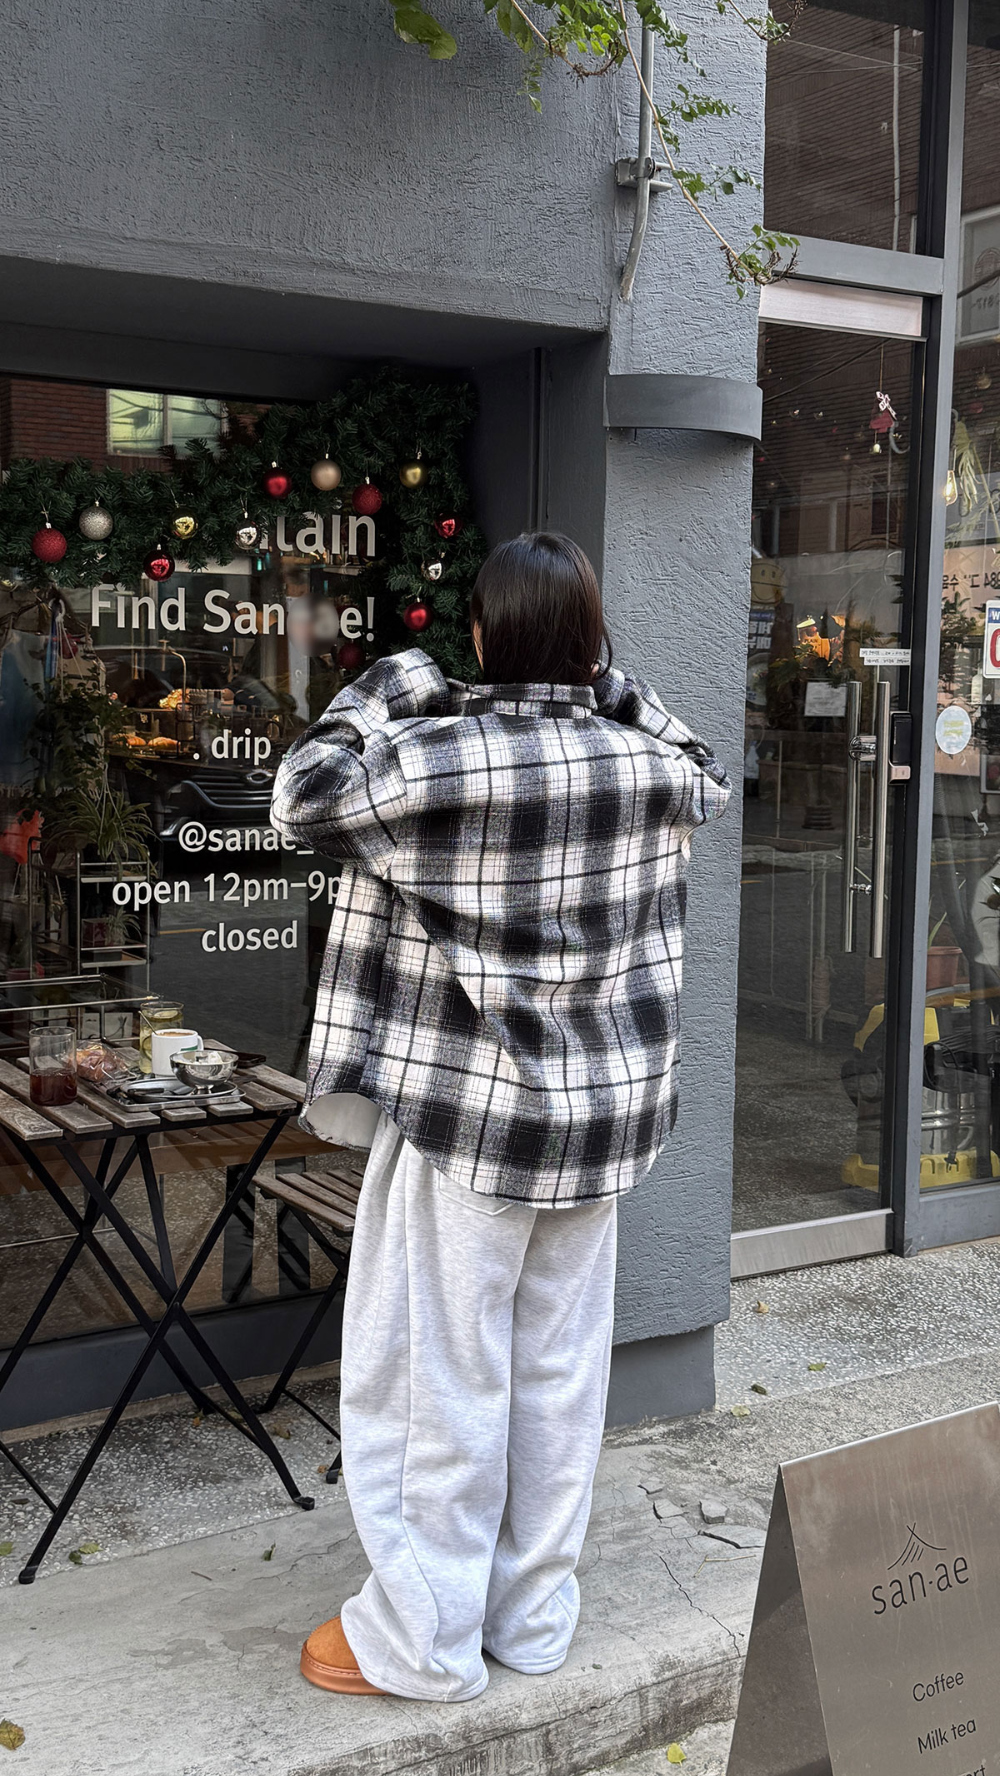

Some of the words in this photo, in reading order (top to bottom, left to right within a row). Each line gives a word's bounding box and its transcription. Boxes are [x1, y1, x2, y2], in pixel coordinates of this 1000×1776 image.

[91, 583, 186, 631] Find
[211, 728, 272, 766] drip
[112, 880, 190, 911] open
[201, 920, 298, 953] closed
[912, 1672, 964, 1702] Coffee
[917, 1727, 949, 1755] Milk
[950, 1719, 977, 1740] tea
